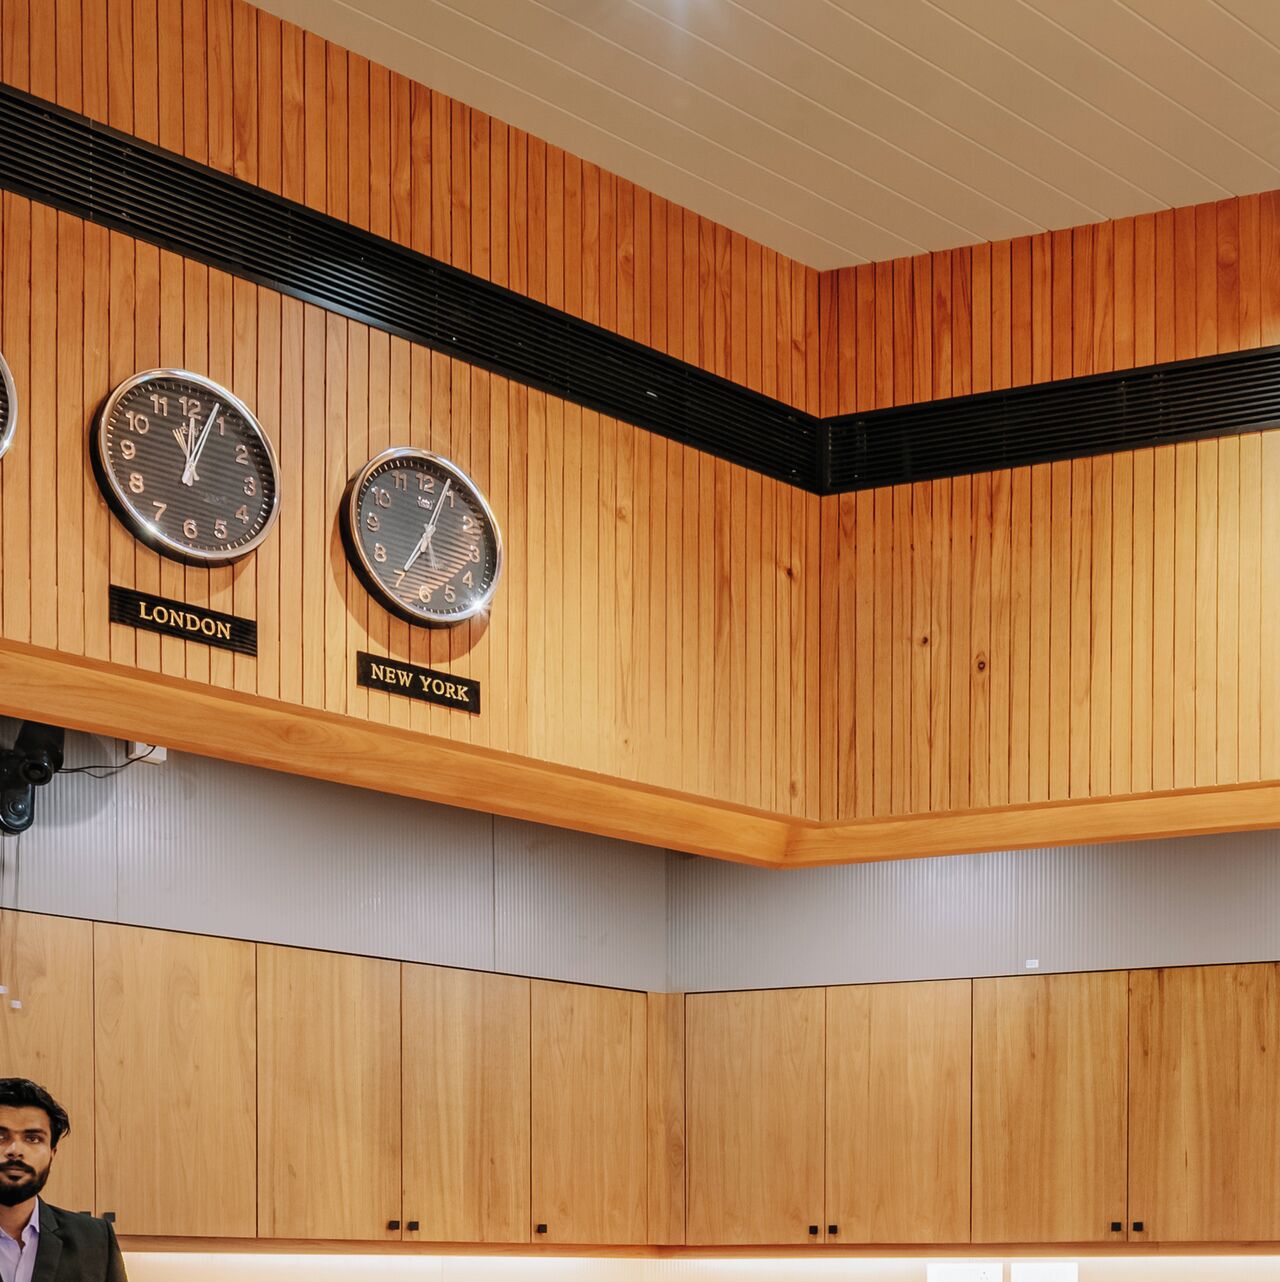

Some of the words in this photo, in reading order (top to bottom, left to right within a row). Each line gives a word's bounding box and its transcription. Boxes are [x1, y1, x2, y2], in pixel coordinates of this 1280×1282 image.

[150, 394, 168, 416] 11
[179, 396, 201, 420] 12
[125, 411, 149, 434] 10
[216, 416, 226, 436] 1
[120, 440, 136, 460] 9
[236, 444, 248, 465] 2
[129, 472, 145, 493] 8
[244, 476, 256, 496] 3
[391, 471, 408, 490] 11
[416, 473, 435, 494] 12
[371, 487, 391, 508] 10
[447, 490, 455, 507] 1
[152, 501, 167, 521] 7
[235, 505, 249, 524] 4
[183, 520, 198, 538] 6
[214, 520, 227, 539] 5
[366, 513, 379, 532] 9
[463, 516, 474, 533] 2
[374, 543, 387, 562] 8
[469, 546, 480, 563] 3
[393, 571, 406, 588] 7
[462, 571, 473, 588] 4
[418, 586, 431, 603] 6
[444, 585, 456, 602] 5
[140, 602, 231, 640] LONDON
[371, 663, 413, 688] NEW
[419, 675, 469, 702] YORK
